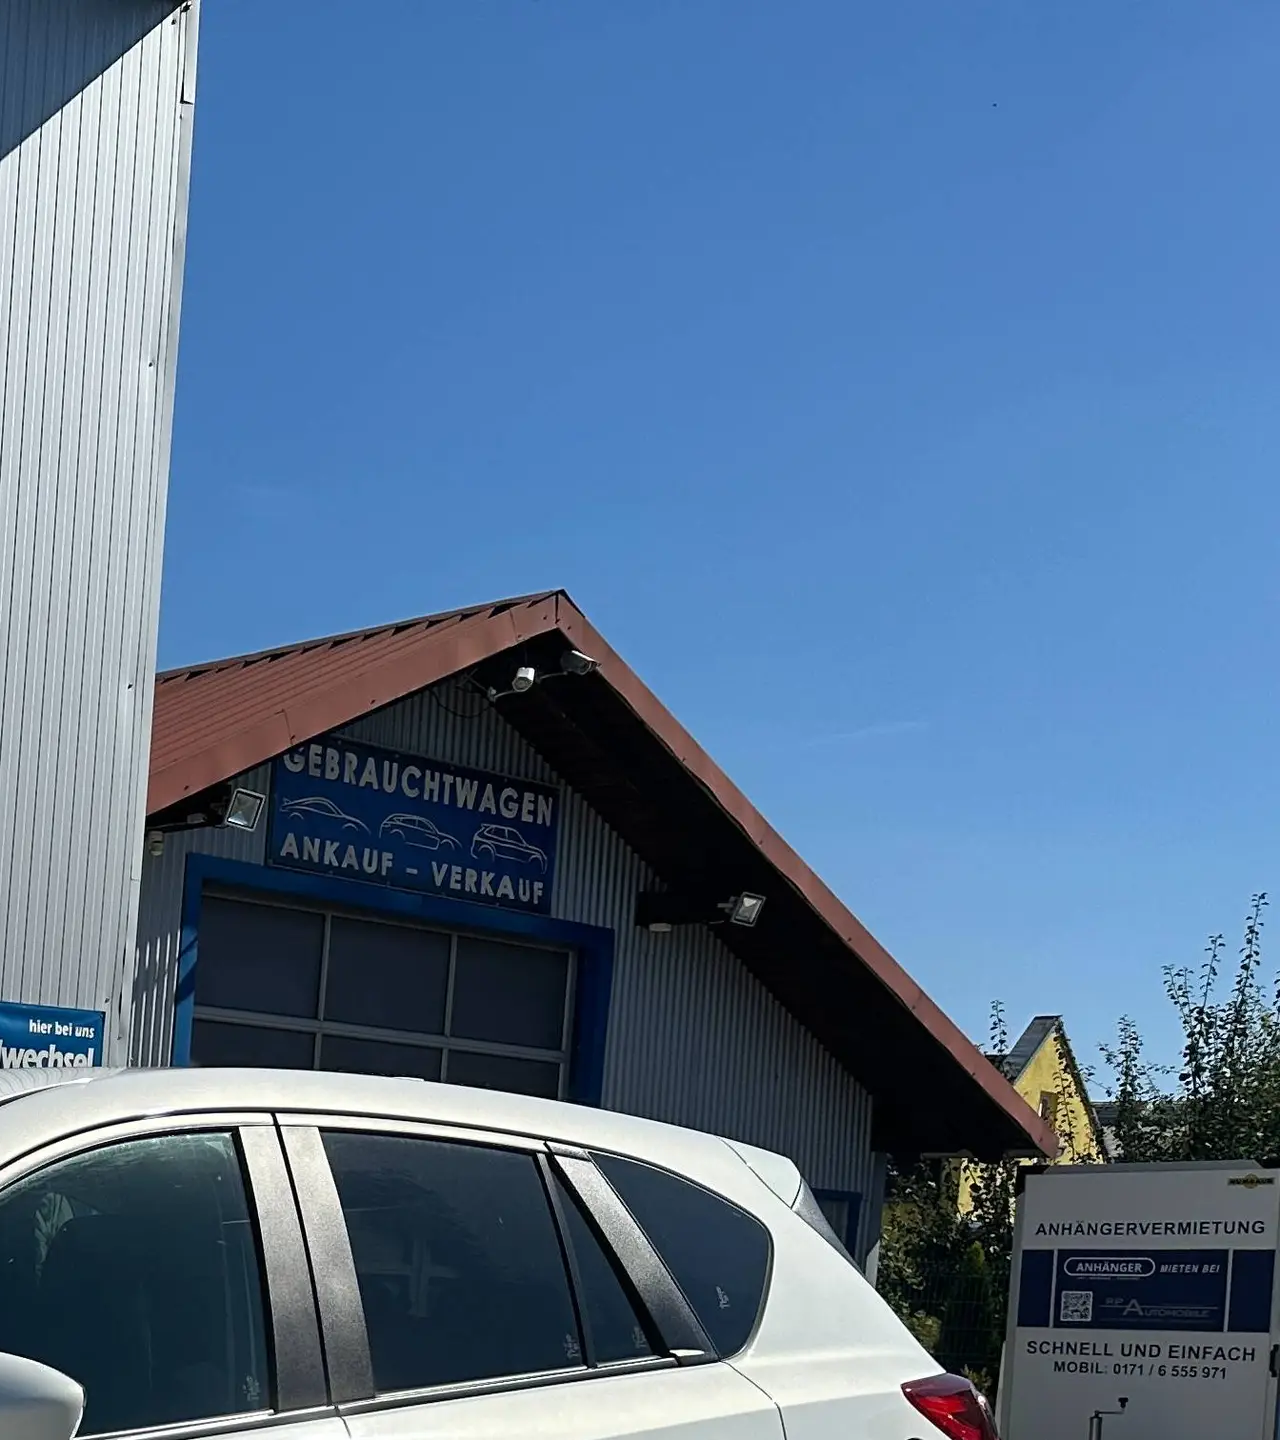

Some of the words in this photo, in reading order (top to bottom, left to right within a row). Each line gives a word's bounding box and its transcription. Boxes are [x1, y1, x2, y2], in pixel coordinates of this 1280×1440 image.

[283, 744, 553, 827] GEBRAUCHTWAGEN
[280, 832, 394, 876] ANKAUF
[431, 861, 544, 905] VERKAUF
[28, 1017, 53, 1035] hier
[55, 1021, 73, 1038] bei
[75, 1024, 95, 1040] uns
[1035, 1220, 1266, 1237] ANHÄNGERVERMIETUNG
[1076, 1261, 1143, 1273] ANHÄNGER
[1160, 1264, 1198, 1273] MIETEN
[1202, 1264, 1221, 1273] BEI
[1026, 1340, 1114, 1358] SCHNELL
[1120, 1342, 1161, 1358] UND
[1167, 1343, 1255, 1362] EINFACH
[1053, 1360, 1108, 1375] MOBIL:
[1113, 1362, 1144, 1376] 0171
[1148, 1363, 1153, 1376] /
[1158, 1364, 1166, 1377] 6
[1171, 1364, 1197, 1378] 555
[1202, 1365, 1227, 1380] 971
